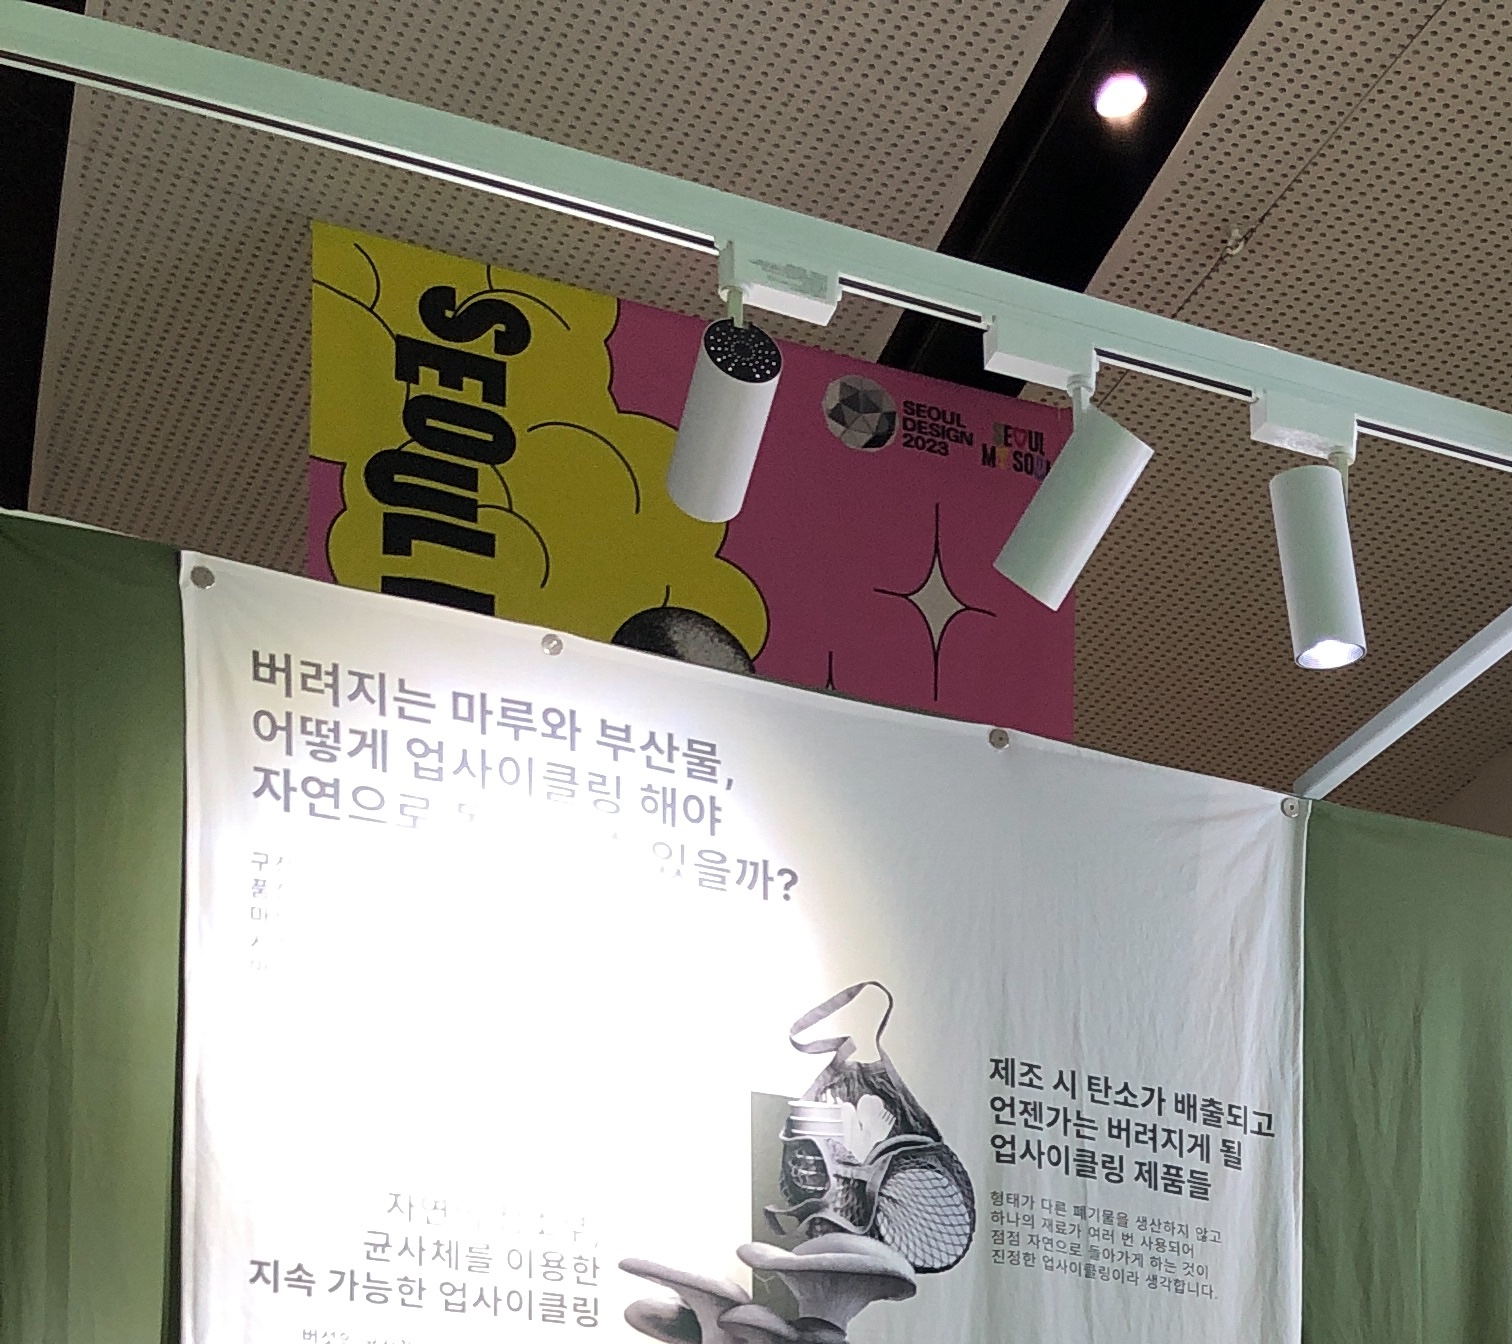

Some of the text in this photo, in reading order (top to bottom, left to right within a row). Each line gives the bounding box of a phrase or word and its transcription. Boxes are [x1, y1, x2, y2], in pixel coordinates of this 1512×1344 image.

[363, 285, 532, 559] SEOUL
[903, 400, 967, 429] SEOUL
[903, 417, 974, 446] DESIGN
[903, 433, 950, 457] 2023
[251, 649, 734, 791] 버려지는 마루와 부산물,
[252, 709, 389, 773] 어떻게
[406, 737, 624, 815] 업사이클링
[640, 781, 723, 836] 해야
[252, 765, 431, 829] 자연으로
[989, 1056, 1276, 1138] 제조 시 탄소가 배출되고
[990, 1095, 1243, 1171] 언젠가는 버려지게 될
[990, 1133, 1211, 1201] 업사이클링 제품들
[991, 1190, 1222, 1243] 형태가 다른 폐기물을 생산하지 않고
[991, 1210, 1035, 1230] 하나의
[1088, 1226, 1115, 1244] 여러
[1121, 1231, 1134, 1248] 번
[1140, 1236, 1195, 1258] 사용되어
[363, 1229, 601, 1287] 균사체를 이용한
[991, 1229, 1209, 1280] 점점 자연으로 돌아가게 하는 것이
[991, 1249, 1037, 1268] 진정한
[249, 1259, 600, 1328] 지속 가능한 업사이클링
